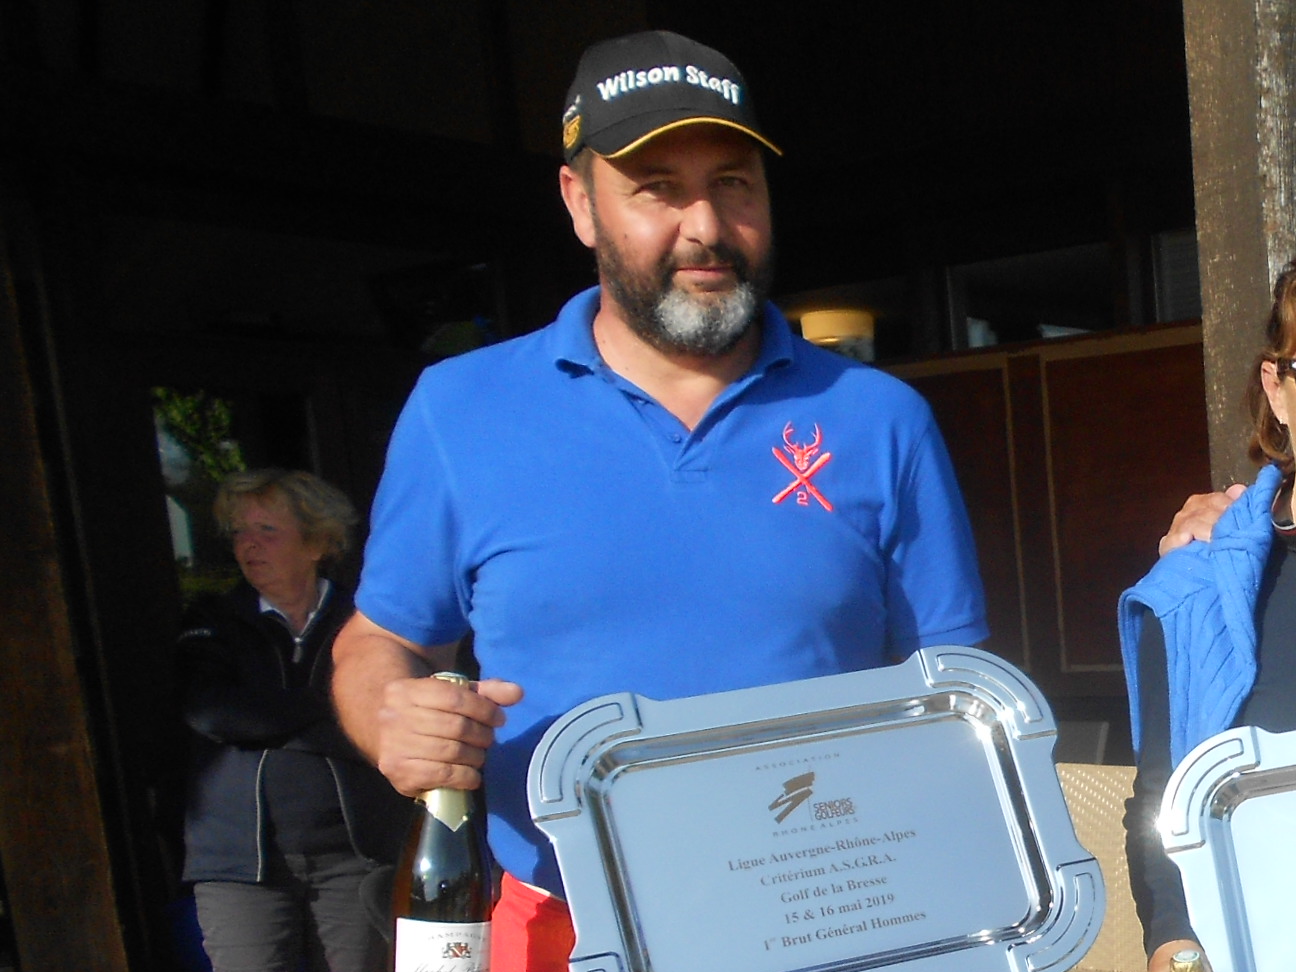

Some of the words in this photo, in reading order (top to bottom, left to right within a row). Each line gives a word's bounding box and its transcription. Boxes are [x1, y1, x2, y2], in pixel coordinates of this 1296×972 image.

[597, 65, 679, 101] Wilson
[685, 65, 740, 105] Staff
[755, 752, 840, 771] ASSOCIATION
[813, 797, 852, 811] SENIORS
[814, 807, 855, 820] GOLFEURS
[728, 857, 766, 872] Ligue
[769, 827, 917, 864] Auvergne-Rhône-Alpes
[760, 867, 826, 887] Critérium
[829, 854, 896, 874] A.S.G.R.A.
[780, 885, 809, 904] Golf
[813, 883, 828, 897] de
[830, 882, 843, 894] la
[847, 875, 888, 891] Bresse
[784, 912, 799, 924] 15
[803, 909, 815, 920] &
[820, 904, 834, 917] 16
[839, 898, 863, 912] mai
[866, 893, 895, 908] 2019
[782, 932, 812, 947] Brut
[815, 919, 868, 940] Général
[871, 910, 926, 929] Hommes
